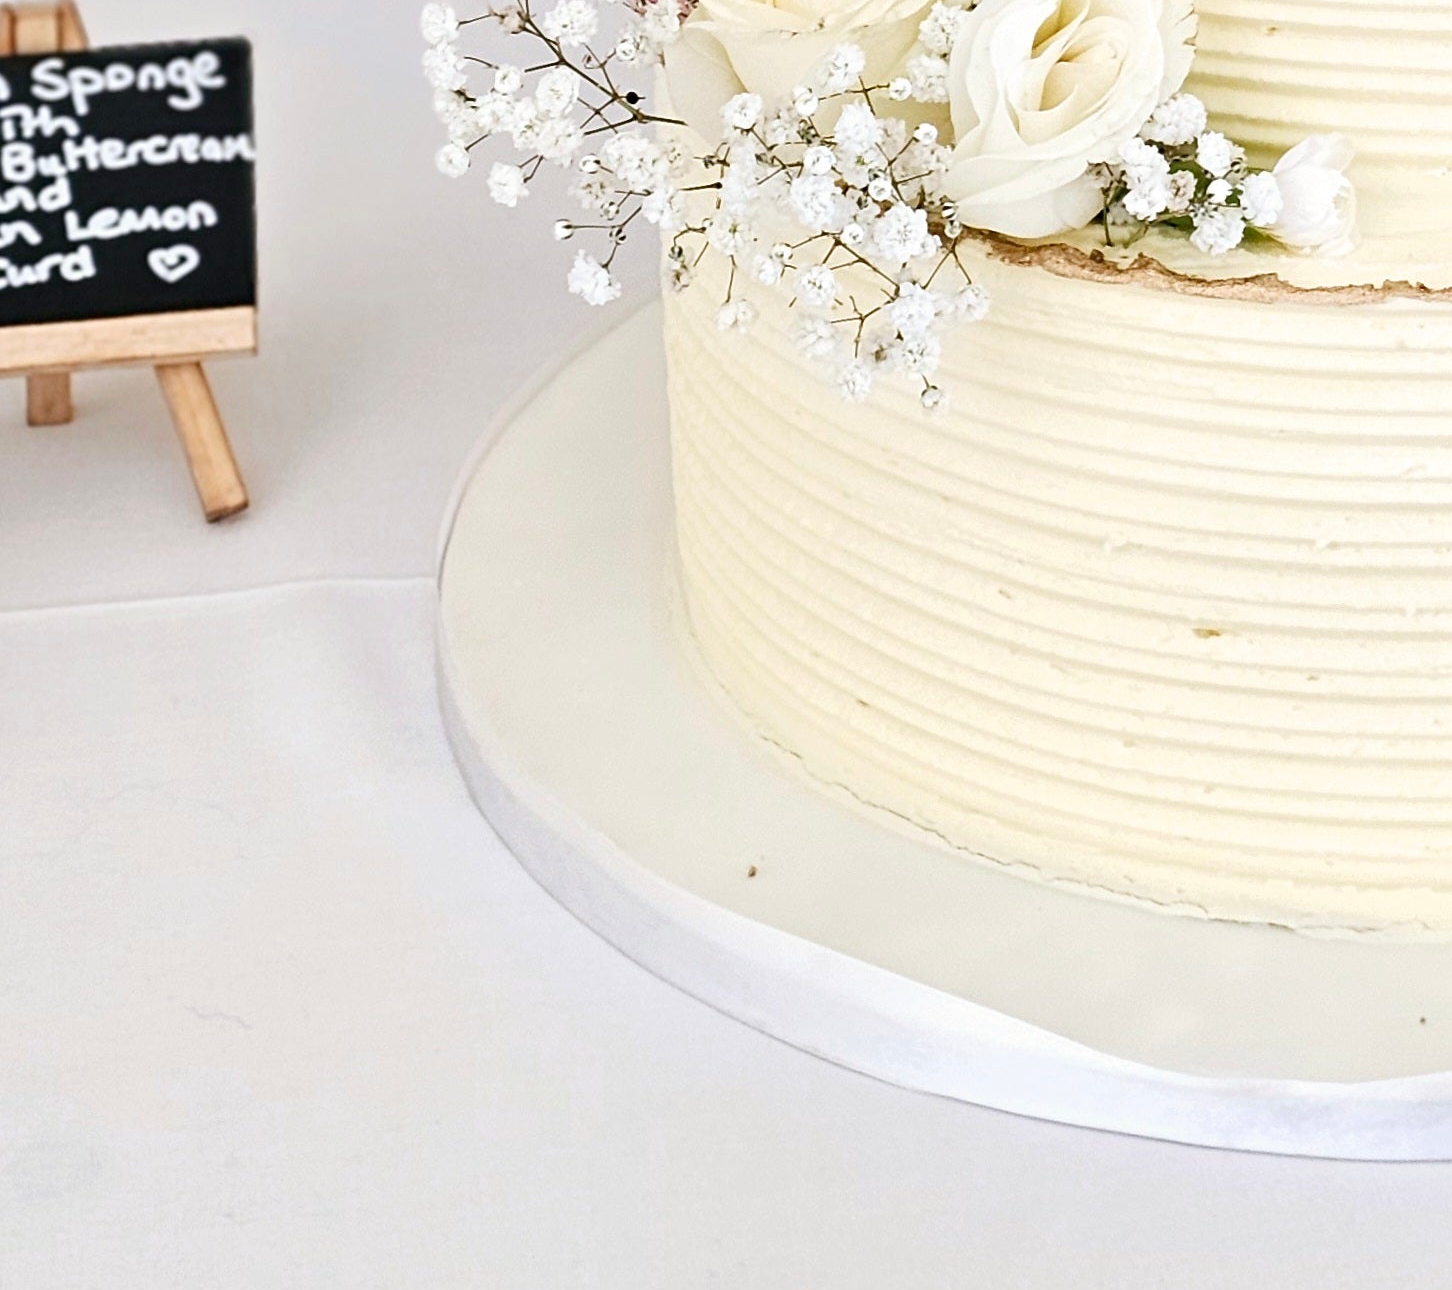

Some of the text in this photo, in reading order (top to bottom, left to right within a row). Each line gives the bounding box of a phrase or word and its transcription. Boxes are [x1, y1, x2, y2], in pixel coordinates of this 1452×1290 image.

[30, 49, 227, 116] Sponge
[0, 103, 80, 140] ith
[0, 176, 73, 213] nd
[0, 200, 218, 249] n Lemon
